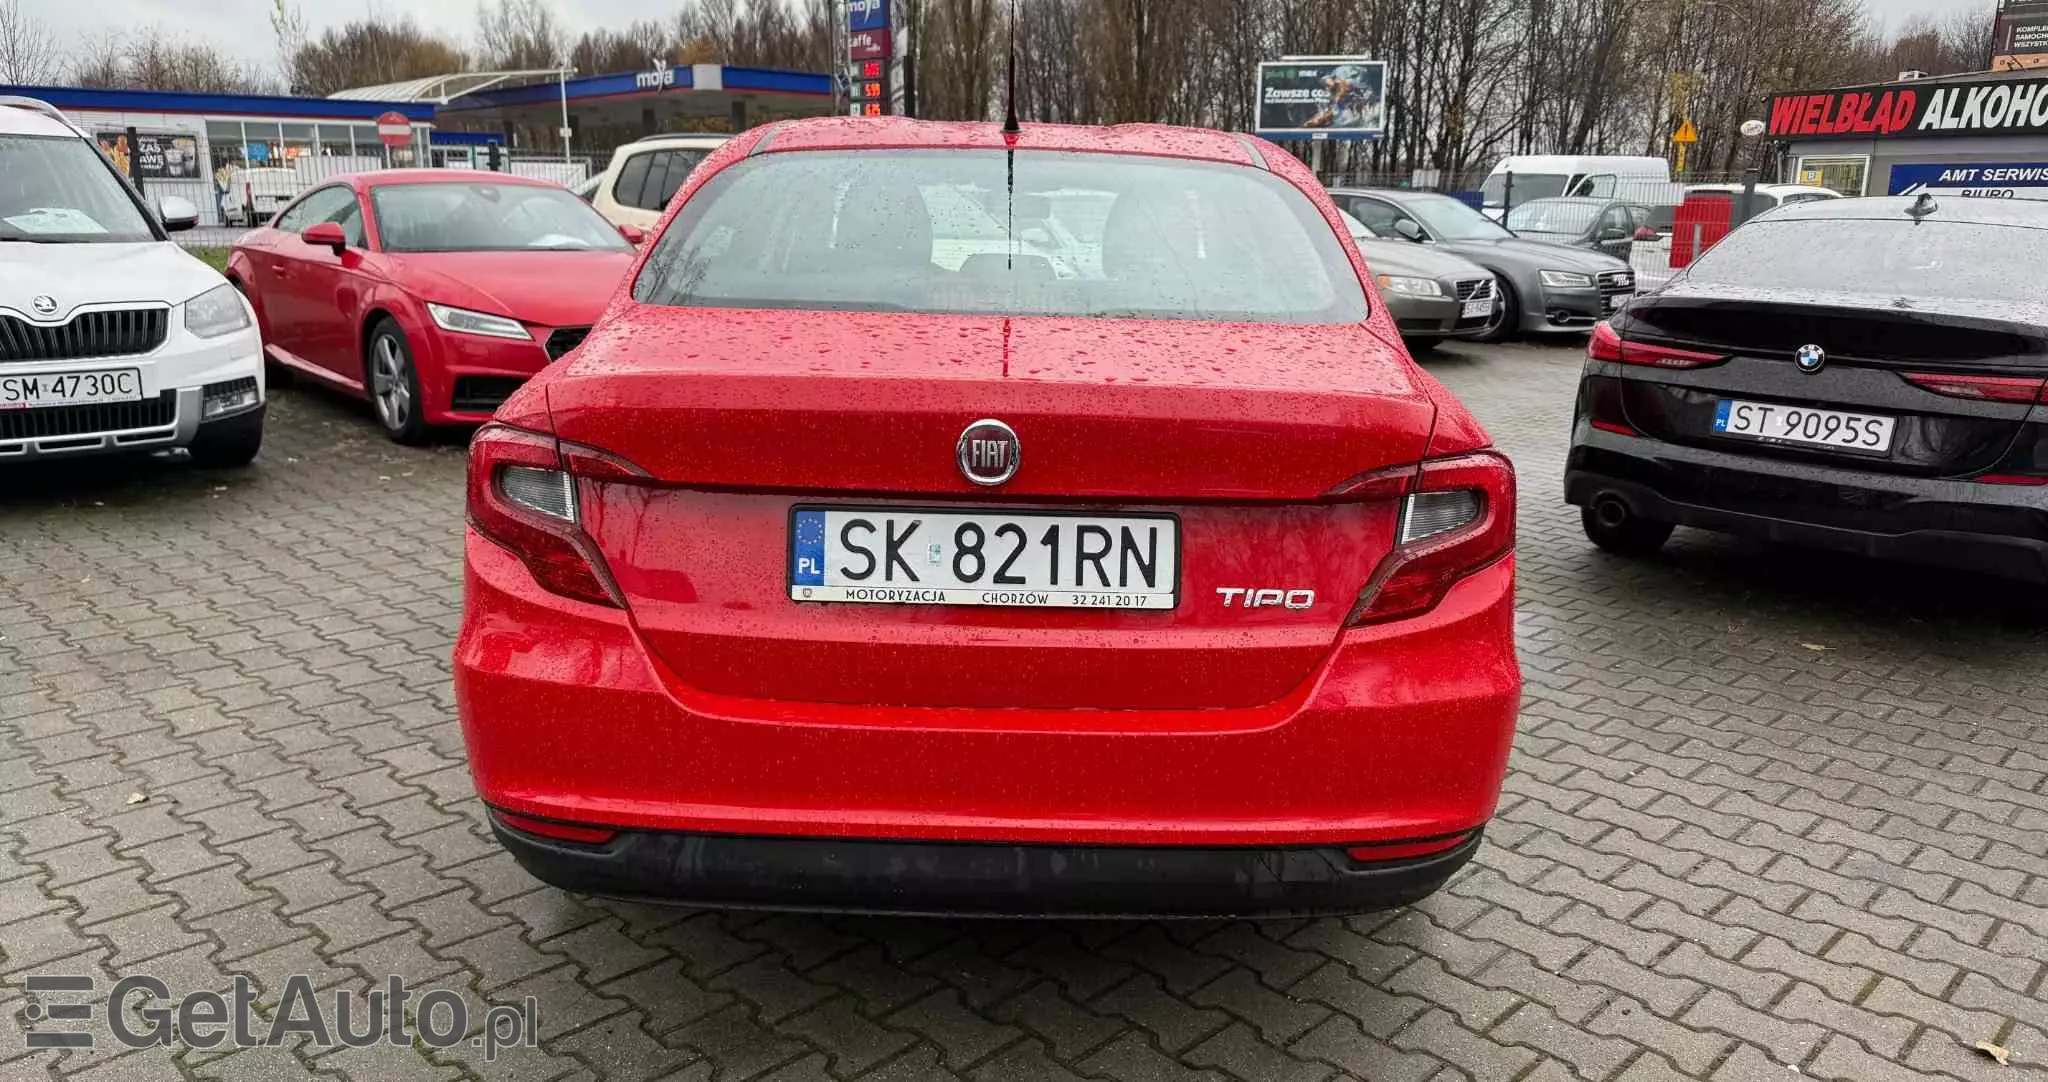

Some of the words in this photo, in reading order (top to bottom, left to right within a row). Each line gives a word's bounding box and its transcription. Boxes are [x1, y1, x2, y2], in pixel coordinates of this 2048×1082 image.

[636, 58, 674, 95] moya
[1265, 88, 1309, 98] Zawsze
[1939, 169, 1979, 182] AMT
[1982, 168, 2048, 181] SERWIS
[3, 378, 40, 401] SM
[51, 372, 133, 398] 4730C
[1715, 418, 1726, 427] PL
[1734, 405, 1774, 433] ST
[1783, 410, 1883, 446] 9095S
[971, 439, 1008, 468] FIAT
[798, 557, 820, 574] PL
[840, 518, 922, 582] SK
[952, 521, 1157, 588] 821RN
[846, 589, 946, 602] MOTORYZACJA
[982, 592, 1049, 604] CHORZÓW
[1072, 594, 1087, 605] 32
[1215, 587, 1315, 609] TIPO
